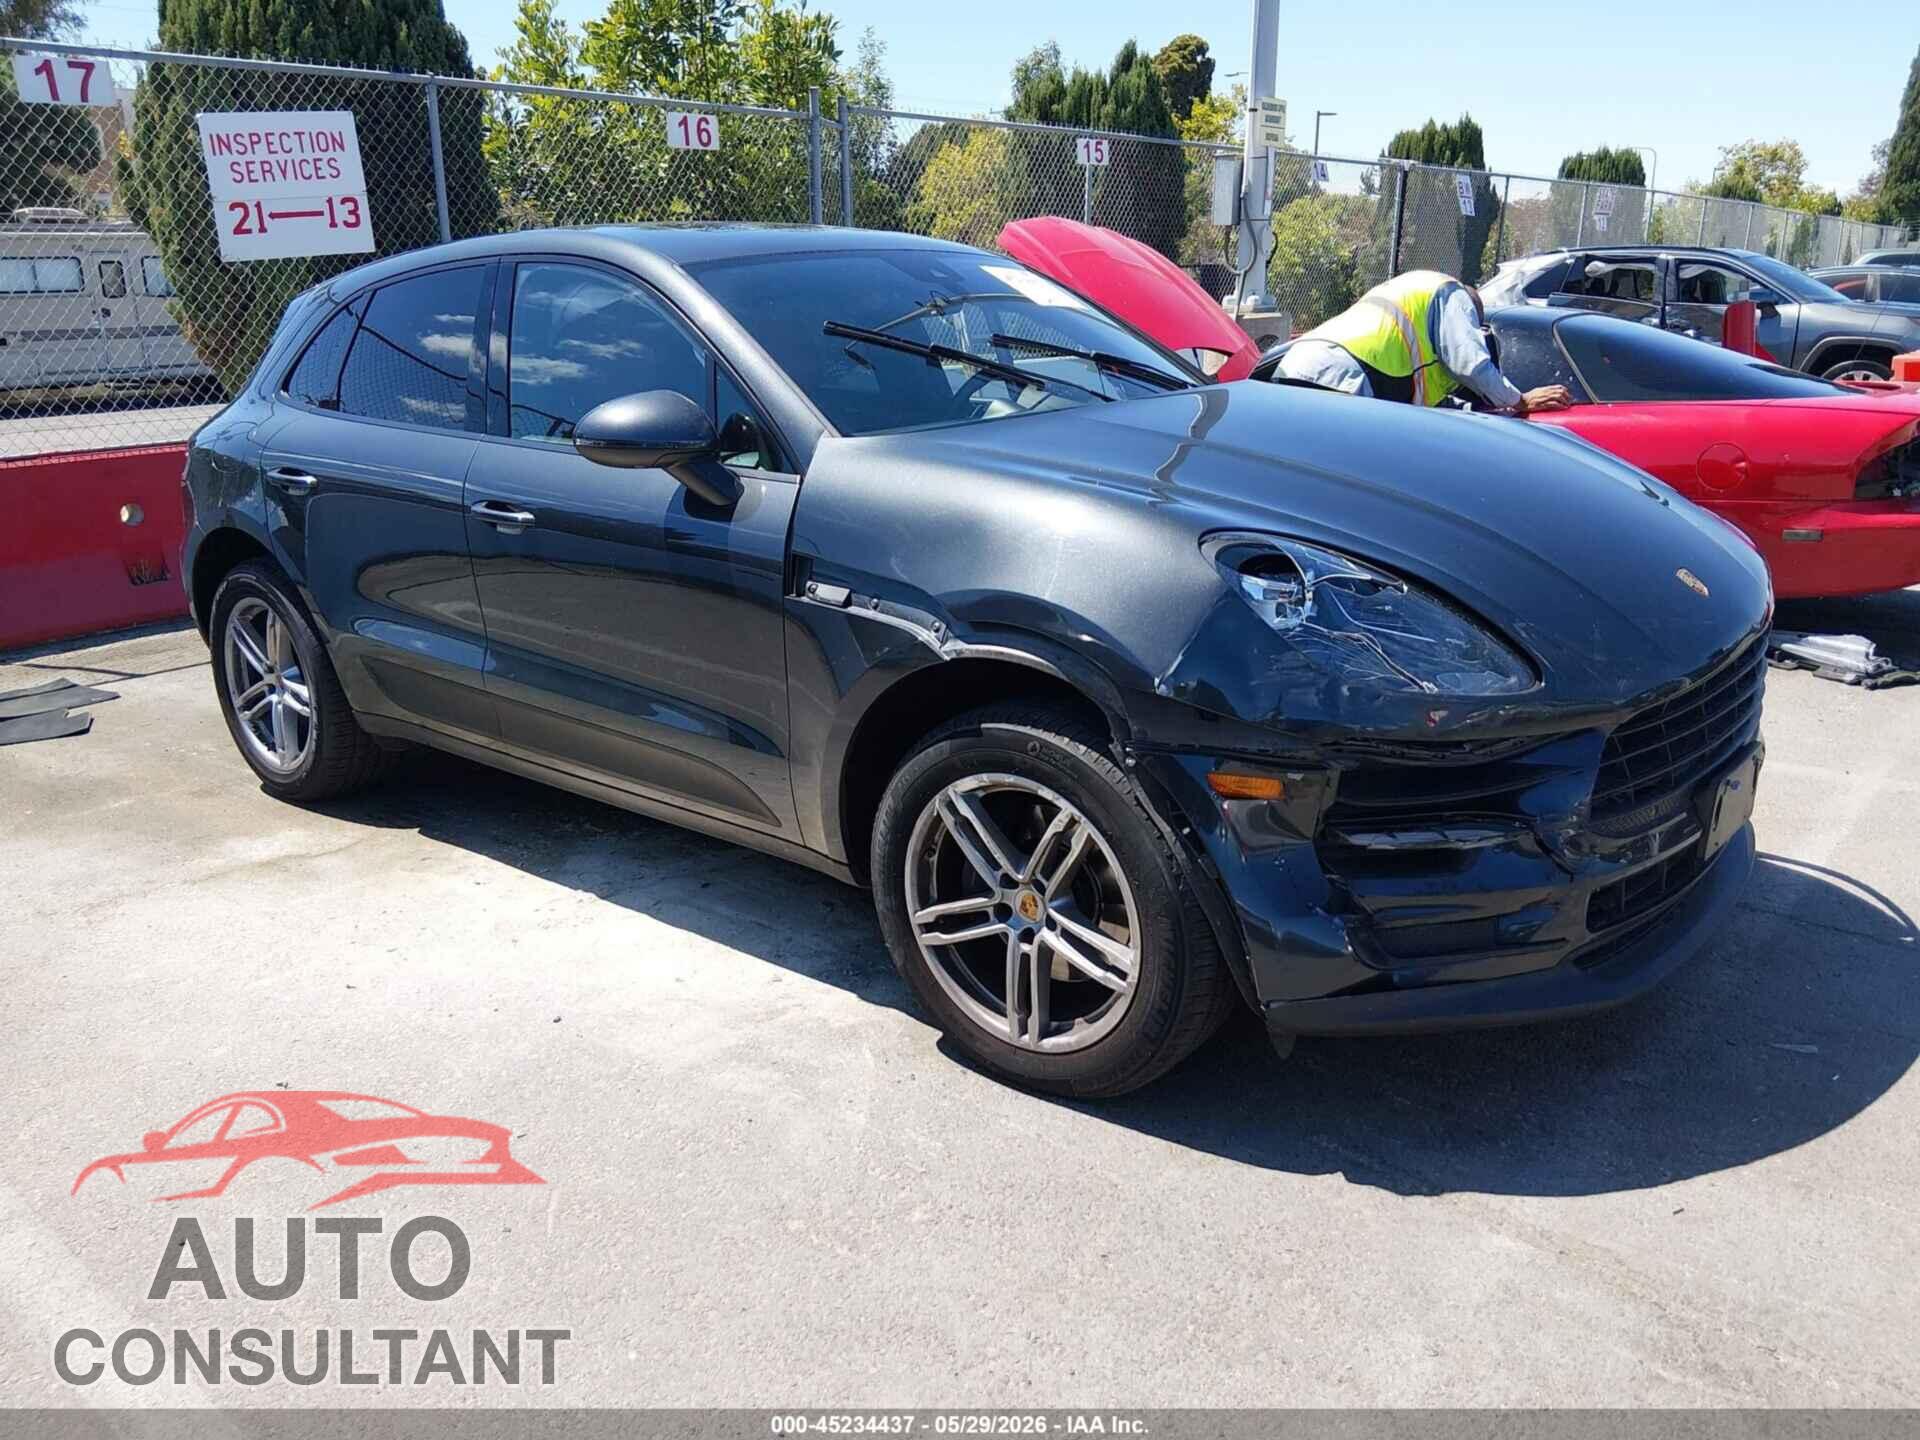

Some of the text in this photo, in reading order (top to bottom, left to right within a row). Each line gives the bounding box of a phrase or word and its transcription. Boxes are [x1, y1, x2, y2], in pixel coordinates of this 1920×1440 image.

[34, 59, 96, 103] 17
[209, 131, 346, 156] INSPECTION
[678, 115, 712, 147] 16
[1083, 140, 1104, 163] 15
[229, 157, 341, 184] SERVICES
[228, 196, 361, 236] 21 13
